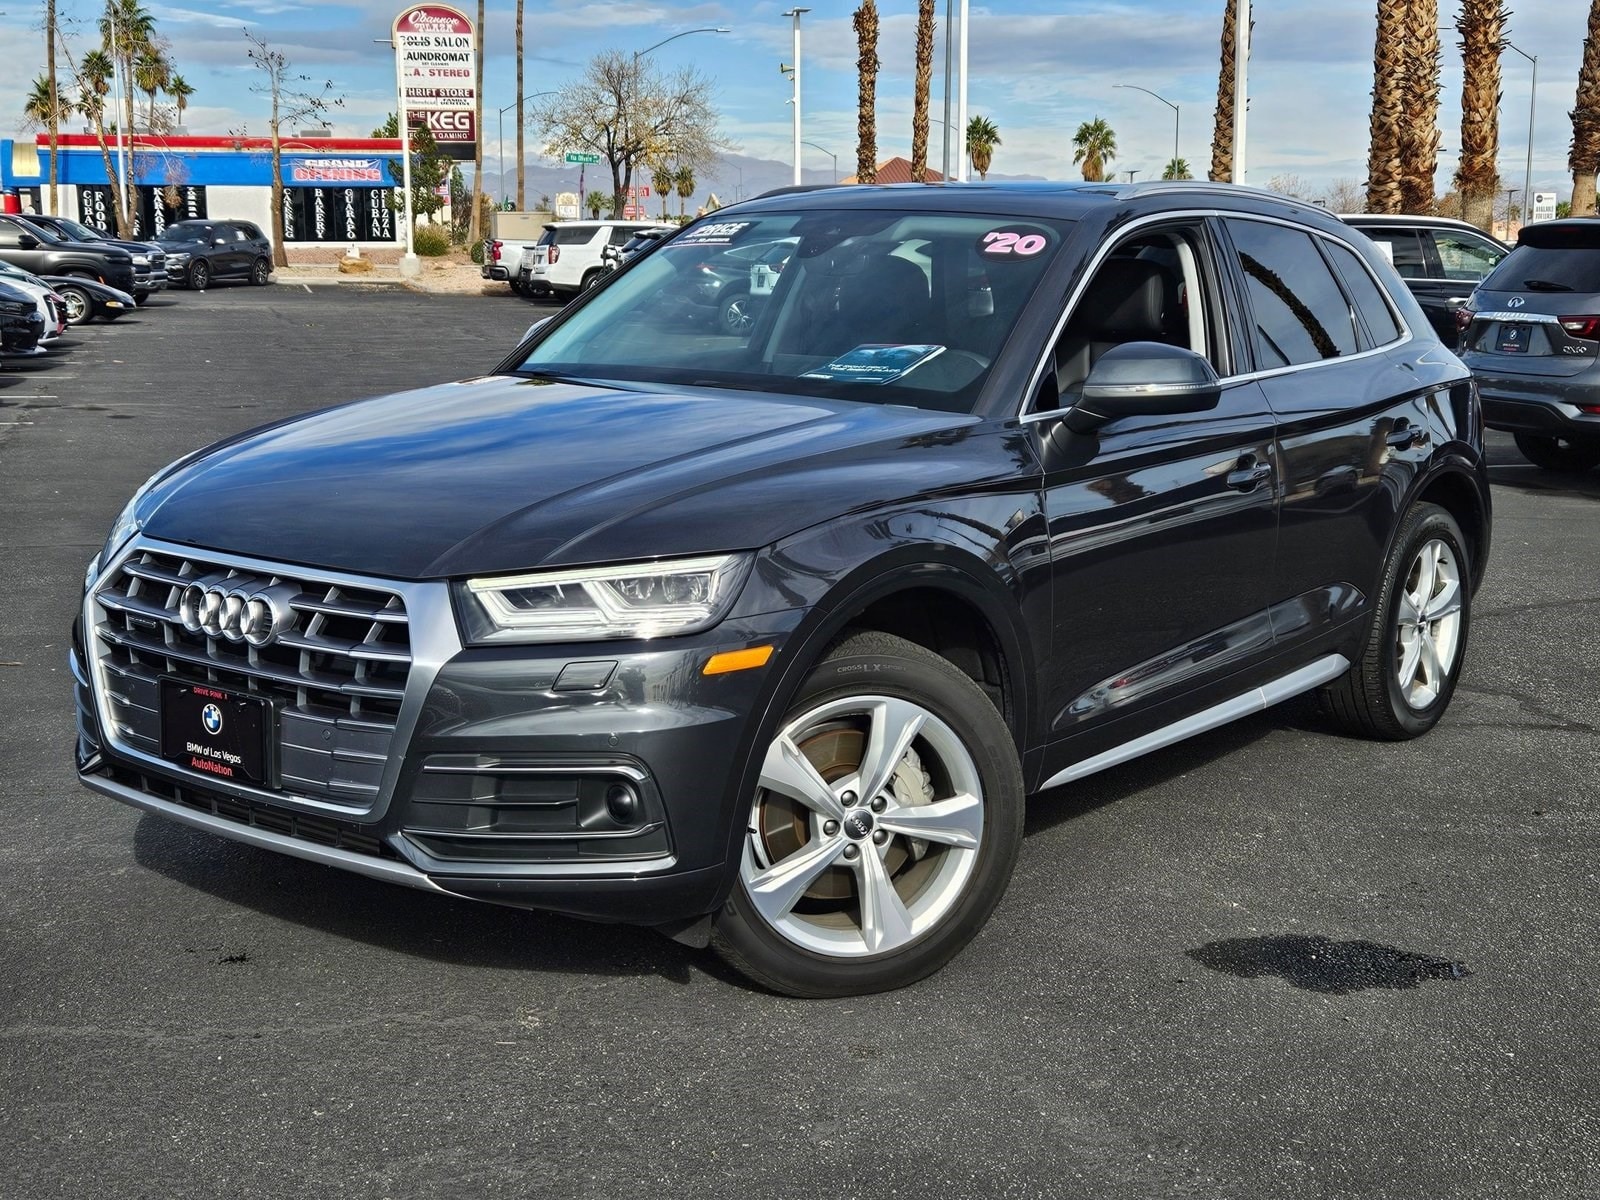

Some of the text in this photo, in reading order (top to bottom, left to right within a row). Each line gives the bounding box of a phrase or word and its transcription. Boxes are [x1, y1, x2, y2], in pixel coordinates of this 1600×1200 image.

[434, 37, 470, 48] SALON
[403, 52, 471, 62] AUNDROMAT
[428, 69, 470, 77] STEREO
[439, 89, 470, 97] STORE
[408, 111, 470, 130] THE KEG
[304, 159, 369, 169] GRAND
[294, 168, 381, 182] OPENING
[94, 191, 107, 231] FOOD
[314, 188, 326, 239] BAKERY
[344, 188, 356, 239] GUARAPO
[370, 189, 391, 238] CUBAN PIZZA
[837, 664, 861, 672] CROSS
[186, 742, 203, 755] BMW
[203, 746, 210, 756] of
[222, 750, 241, 764] Vegas
[192, 757, 233, 777] AutoNation
